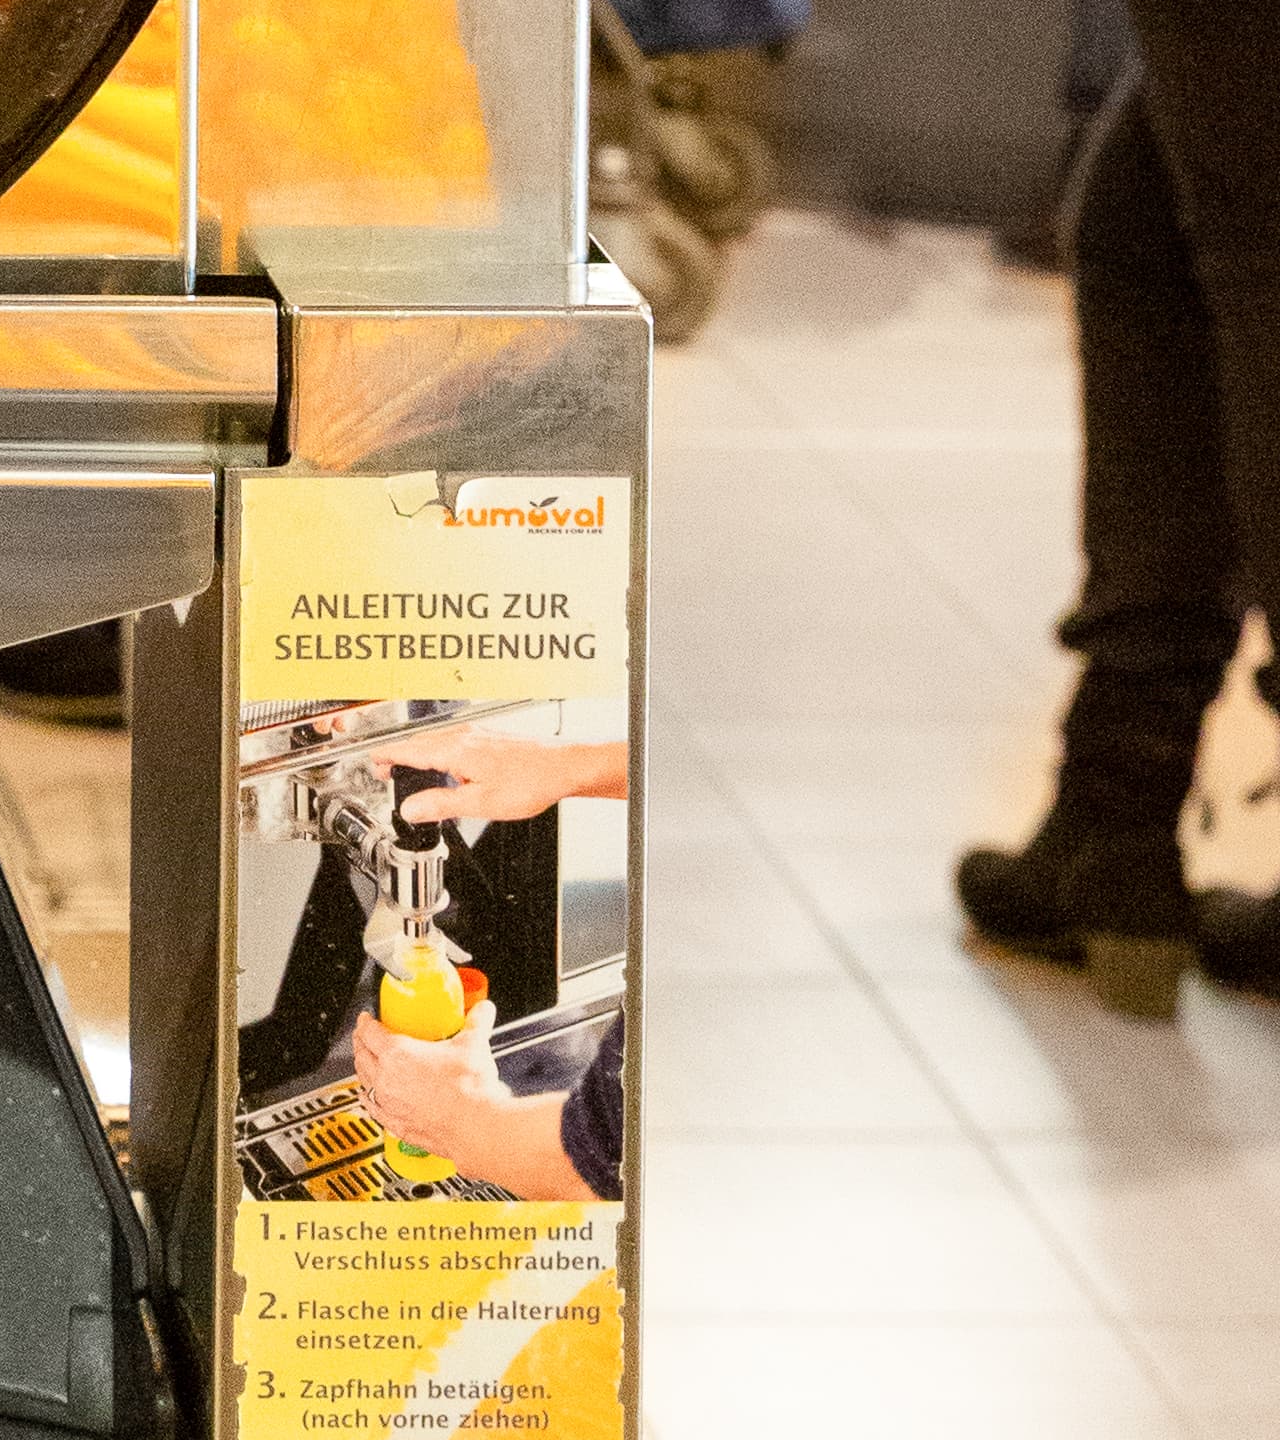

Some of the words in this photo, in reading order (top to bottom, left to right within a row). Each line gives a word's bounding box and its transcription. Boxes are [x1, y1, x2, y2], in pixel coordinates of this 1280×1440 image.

[291, 593, 489, 619] ANLEITUNG
[503, 593, 570, 618] ZUR
[275, 634, 596, 660] SELBSTBEDIENUNG
[260, 1213, 286, 1242] 1.
[296, 1221, 387, 1242] Flasche
[398, 1221, 537, 1241] entnehmen
[547, 1221, 593, 1241] und
[295, 1251, 429, 1271] Verschluss
[440, 1251, 607, 1271] abschrauben.
[258, 1292, 287, 1320] 2.
[298, 1300, 389, 1320] Flasche
[400, 1301, 421, 1320] in
[431, 1300, 468, 1320] die
[479, 1301, 601, 1324] Halterung
[296, 1331, 423, 1351] einsetzen.
[257, 1371, 286, 1400] 3.
[300, 1380, 417, 1403] Zapfhahn
[428, 1380, 552, 1404] betätigen.
[302, 1409, 368, 1431] (nach
[379, 1413, 449, 1429] vorne
[459, 1409, 549, 1431] ziehen)
